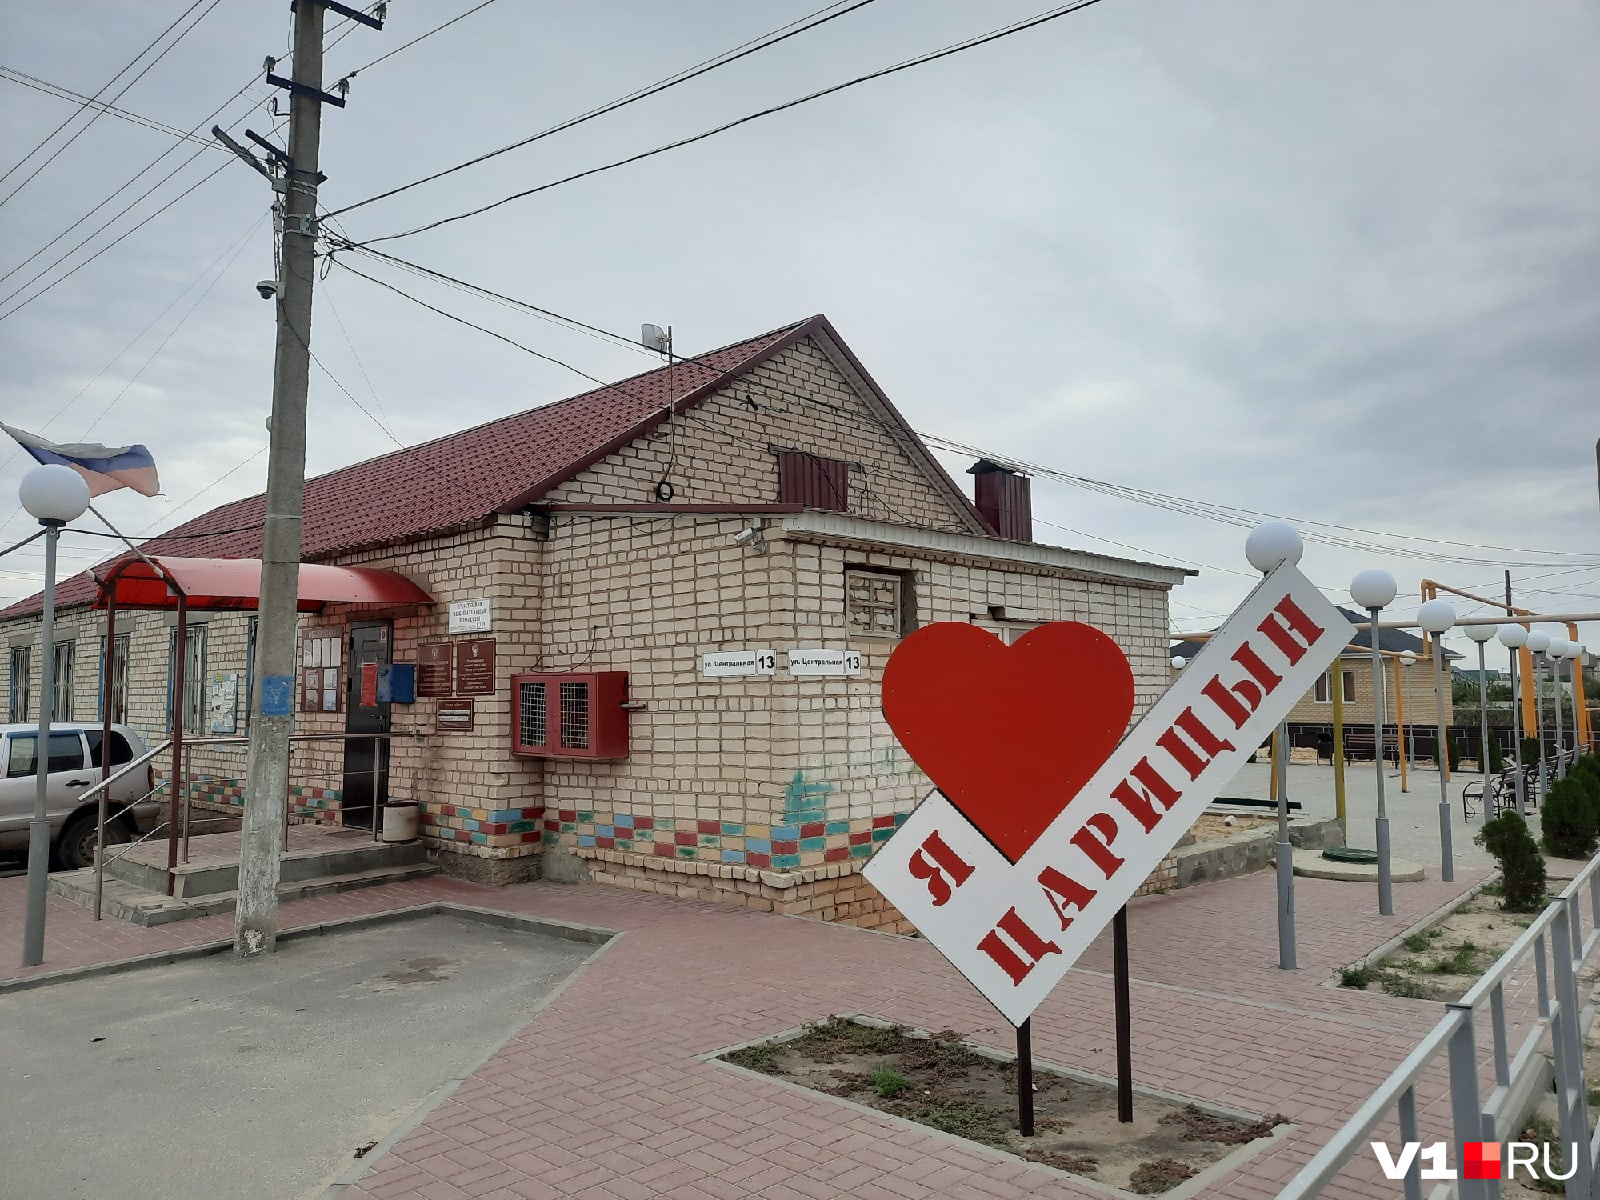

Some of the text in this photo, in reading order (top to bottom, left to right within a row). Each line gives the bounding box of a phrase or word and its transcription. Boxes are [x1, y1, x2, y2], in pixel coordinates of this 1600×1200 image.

[758, 655, 775, 669] 13
[790, 656, 860, 669] ул. Центральная 13
[976, 593, 1326, 987] ЦАРИЦЫН
[908, 829, 976, 907] Я
